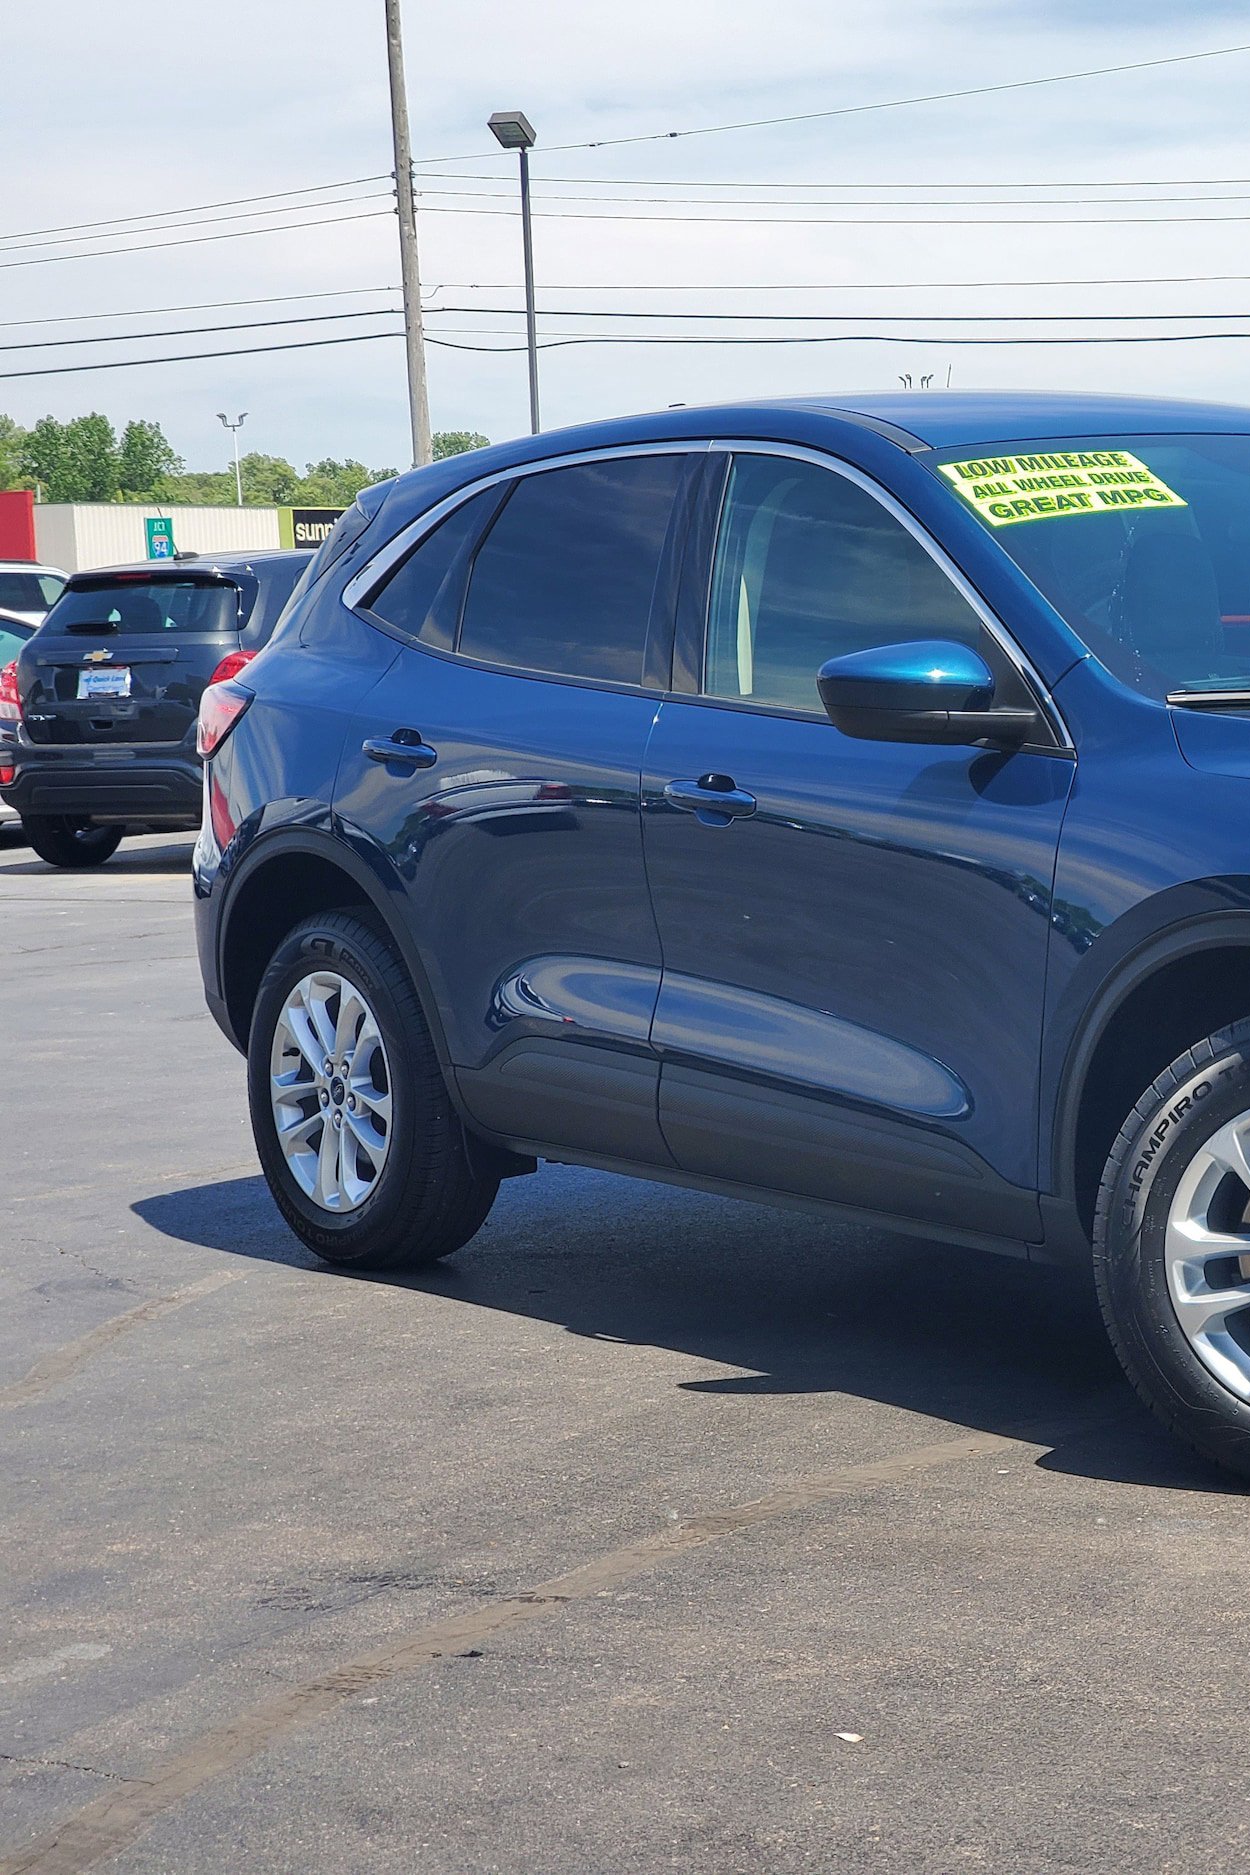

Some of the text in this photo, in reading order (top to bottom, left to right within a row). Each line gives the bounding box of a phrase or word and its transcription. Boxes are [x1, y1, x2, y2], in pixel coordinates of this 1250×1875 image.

[954, 453, 1132, 480] LOW MILEAGE
[972, 471, 1153, 499] ALL WHEEL DRIVE
[988, 488, 1173, 520] GREAT MPG
[154, 541, 168, 554] 94
[1122, 1080, 1214, 1226] CHAMPIRO
